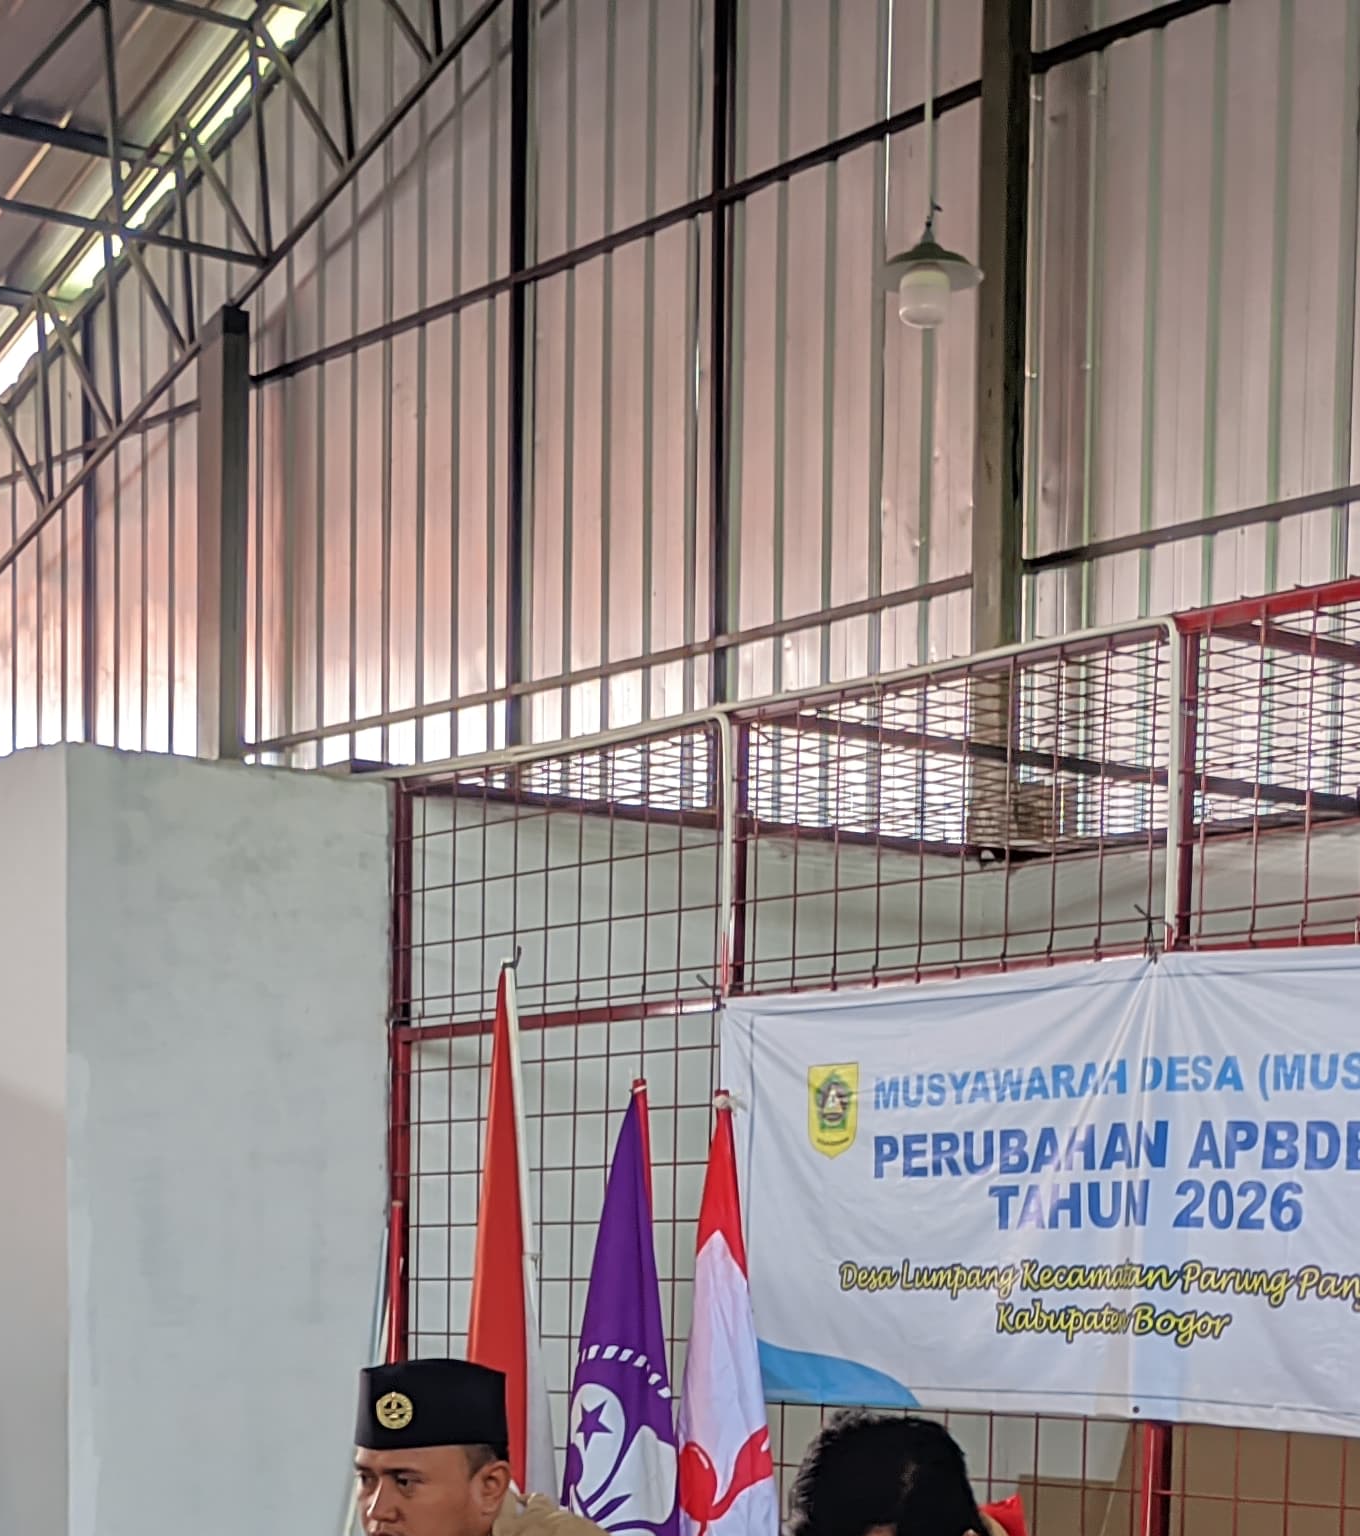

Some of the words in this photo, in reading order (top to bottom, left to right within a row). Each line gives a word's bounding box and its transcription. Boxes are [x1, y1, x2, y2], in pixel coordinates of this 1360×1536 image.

[874, 1058, 1127, 1110] MUSYAWARAH
[1141, 1055, 1244, 1092] DESA
[874, 1120, 1169, 1179] PERUBAHAN
[988, 1179, 1150, 1230] TAHUN
[1173, 1179, 1304, 1232] 2026
[839, 1260, 898, 1292] Desa
[899, 1258, 1019, 1300] Lumpang
[1020, 1258, 1177, 1293] Kecamatan
[1181, 1259, 1295, 1307] Parung
[996, 1299, 1130, 1343] Kabupaten
[1131, 1303, 1231, 1347] Bogor
